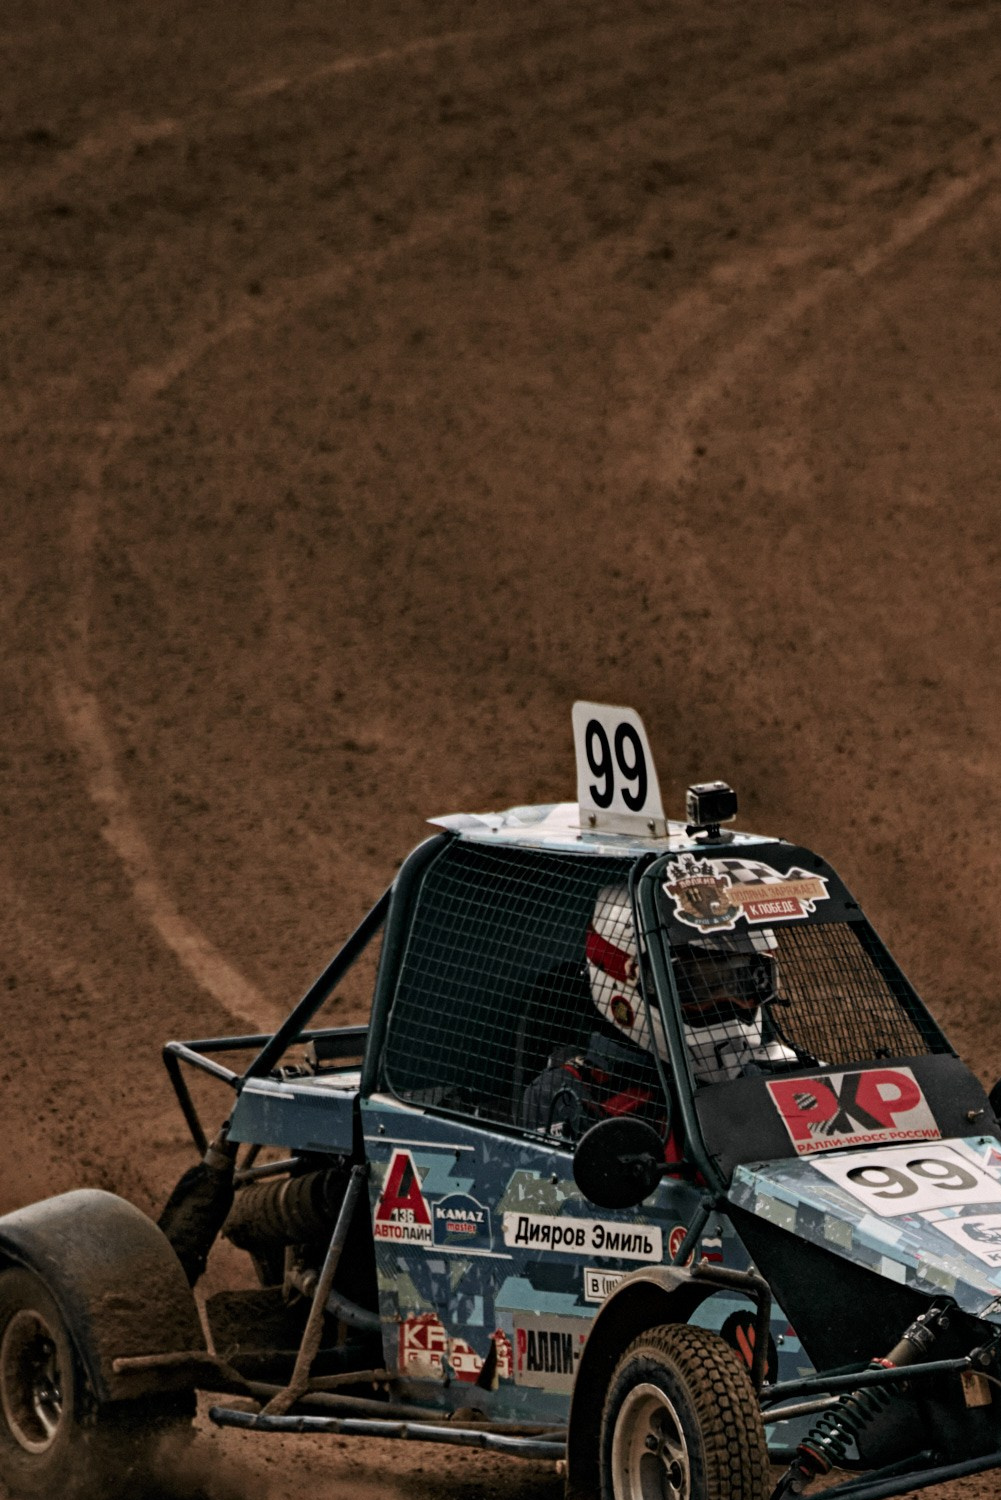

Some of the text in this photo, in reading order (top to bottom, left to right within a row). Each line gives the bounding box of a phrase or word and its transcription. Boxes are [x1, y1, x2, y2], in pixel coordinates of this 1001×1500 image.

[585, 719, 648, 812] 99
[768, 883, 817, 897] ЗАРЯЖАЕТ
[750, 901, 796, 915] К ПОБЕДЕ
[797, 1128, 941, 1153] РАЛЛИ-КРОСС РОССИИ
[846, 1158, 978, 1199] 99
[391, 1208, 415, 1223] 136
[436, 1208, 484, 1222] KAMAZ
[374, 1224, 432, 1240] АВТОЛАЙН
[446, 1222, 476, 1233] master
[515, 1217, 653, 1254] Дияров Эмиль
[516, 1328, 587, 1374] РАЛЛИ-
